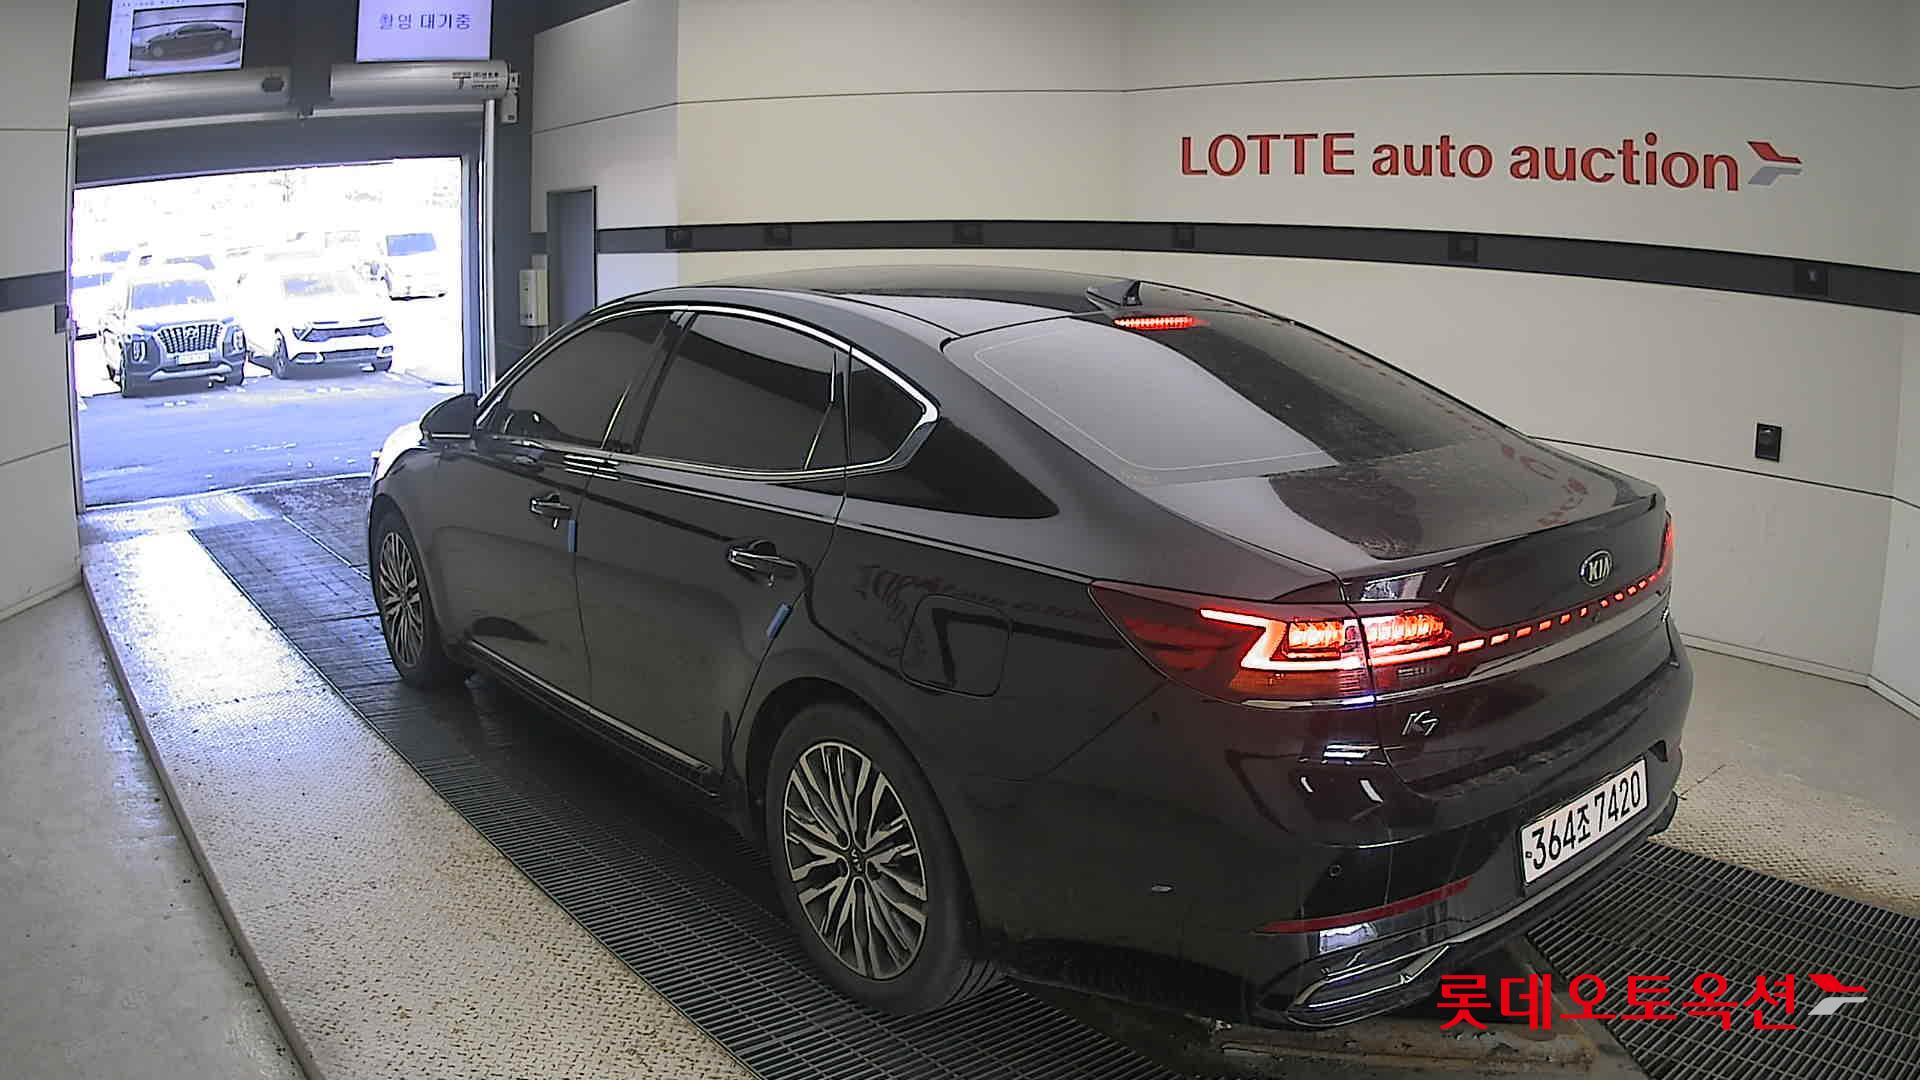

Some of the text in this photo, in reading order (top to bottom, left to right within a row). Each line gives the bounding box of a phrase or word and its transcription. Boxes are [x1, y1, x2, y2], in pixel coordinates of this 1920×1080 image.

[420, 13, 471, 30] 대기중
[1181, 131, 1739, 192] LOTTE auto auction
[1588, 556, 1610, 582] KIA
[1401, 710, 1438, 736] K7
[1531, 770, 1641, 870] 364조 7420
